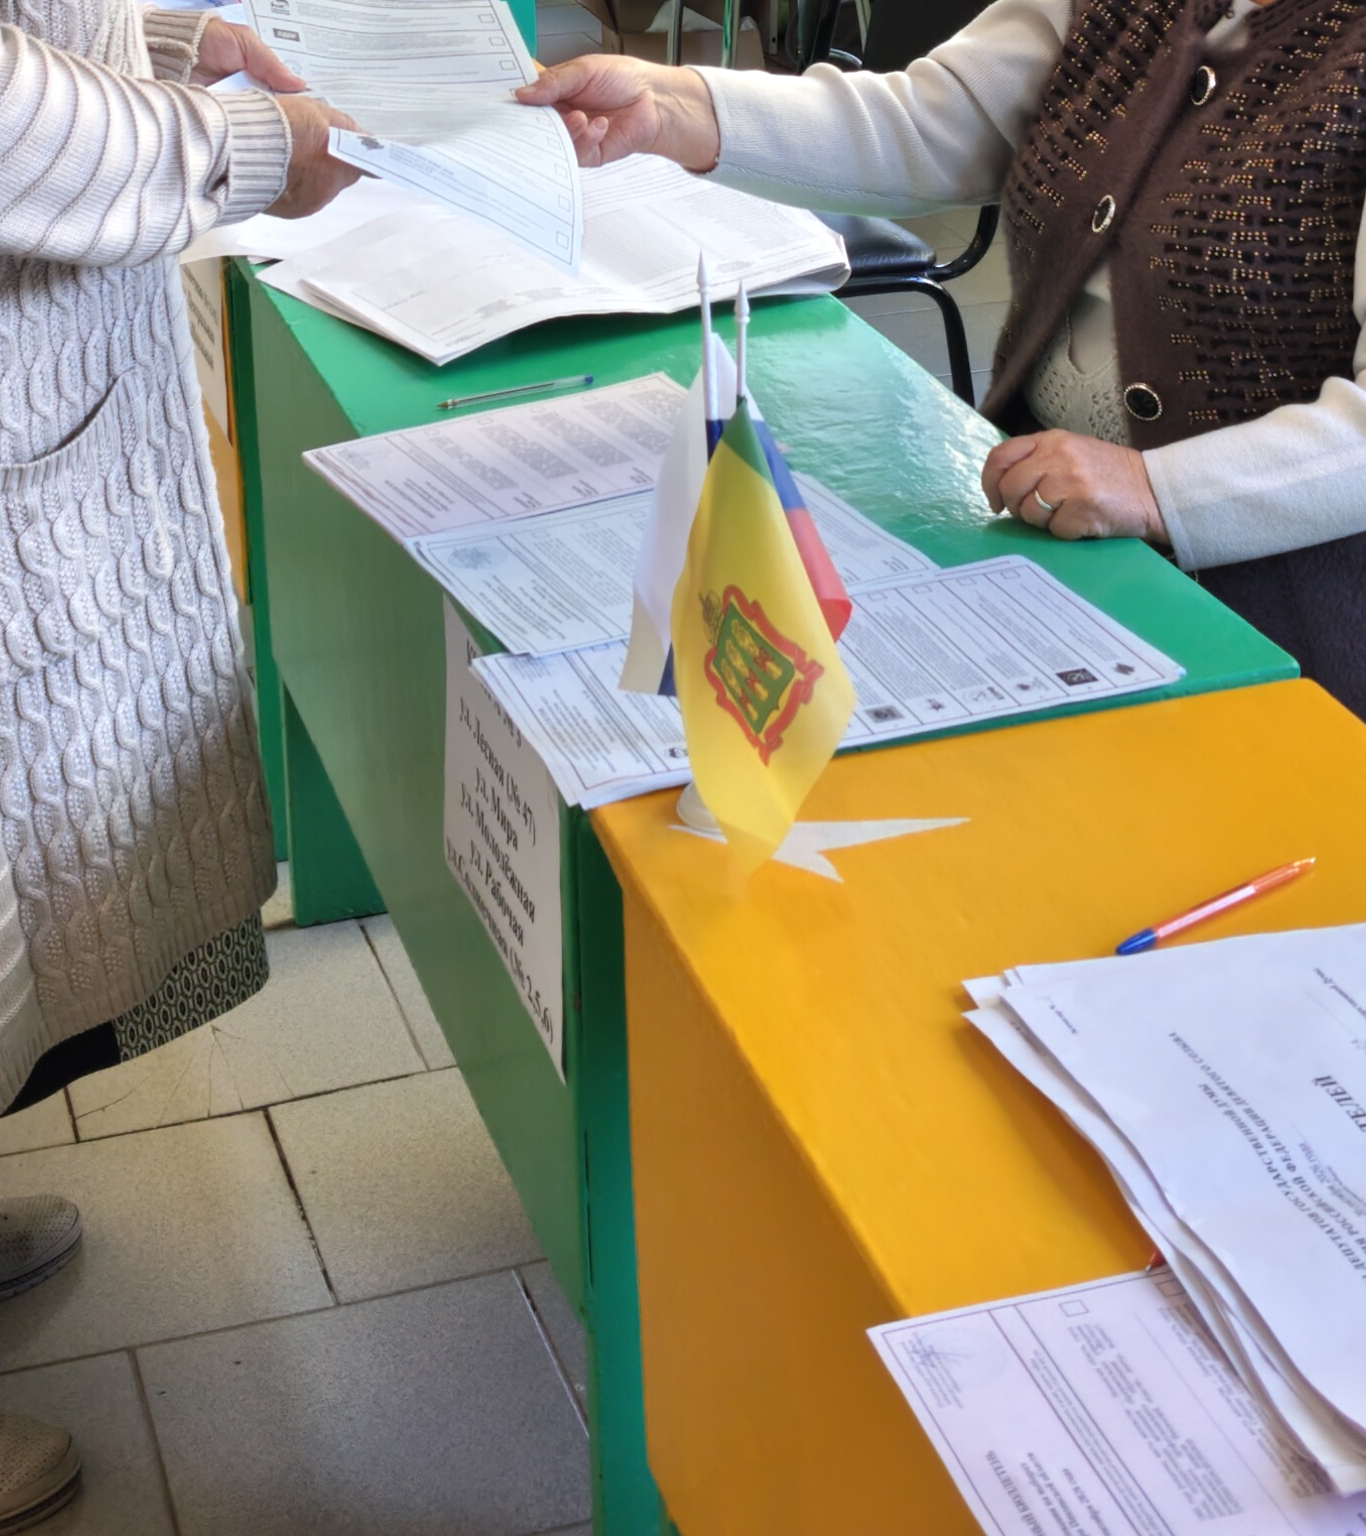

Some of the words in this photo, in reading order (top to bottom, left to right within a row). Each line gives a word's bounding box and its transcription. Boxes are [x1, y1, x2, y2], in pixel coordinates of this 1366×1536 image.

[460, 696, 472, 732] ул.
[473, 716, 505, 787] Лесная
[521, 800, 536, 847] 47)
[476, 766, 489, 804] ул.
[491, 785, 518, 852] Мира
[460, 781, 474, 818] ул.
[475, 800, 535, 924] Молодёжная
[470, 839, 484, 876] ул.
[486, 861, 524, 948] Рабочая
[1197, 1081, 1229, 1110] ДУМЫ
[1222, 1107, 1312, 1214] ГОСУДАРСТВЕННОЙ
[1240, 1103, 1299, 1174] ФЕДЕРАЦИИ
[1290, 1174, 1359, 1238] РОССИЙСКОЙ
[1307, 1161, 1330, 1186] 2026
[982, 1449, 1031, 1513] БЮЛЛЕТЕНЬ
[1019, 1461, 1045, 1495] выборах
[1071, 1485, 1089, 1504] 2026
